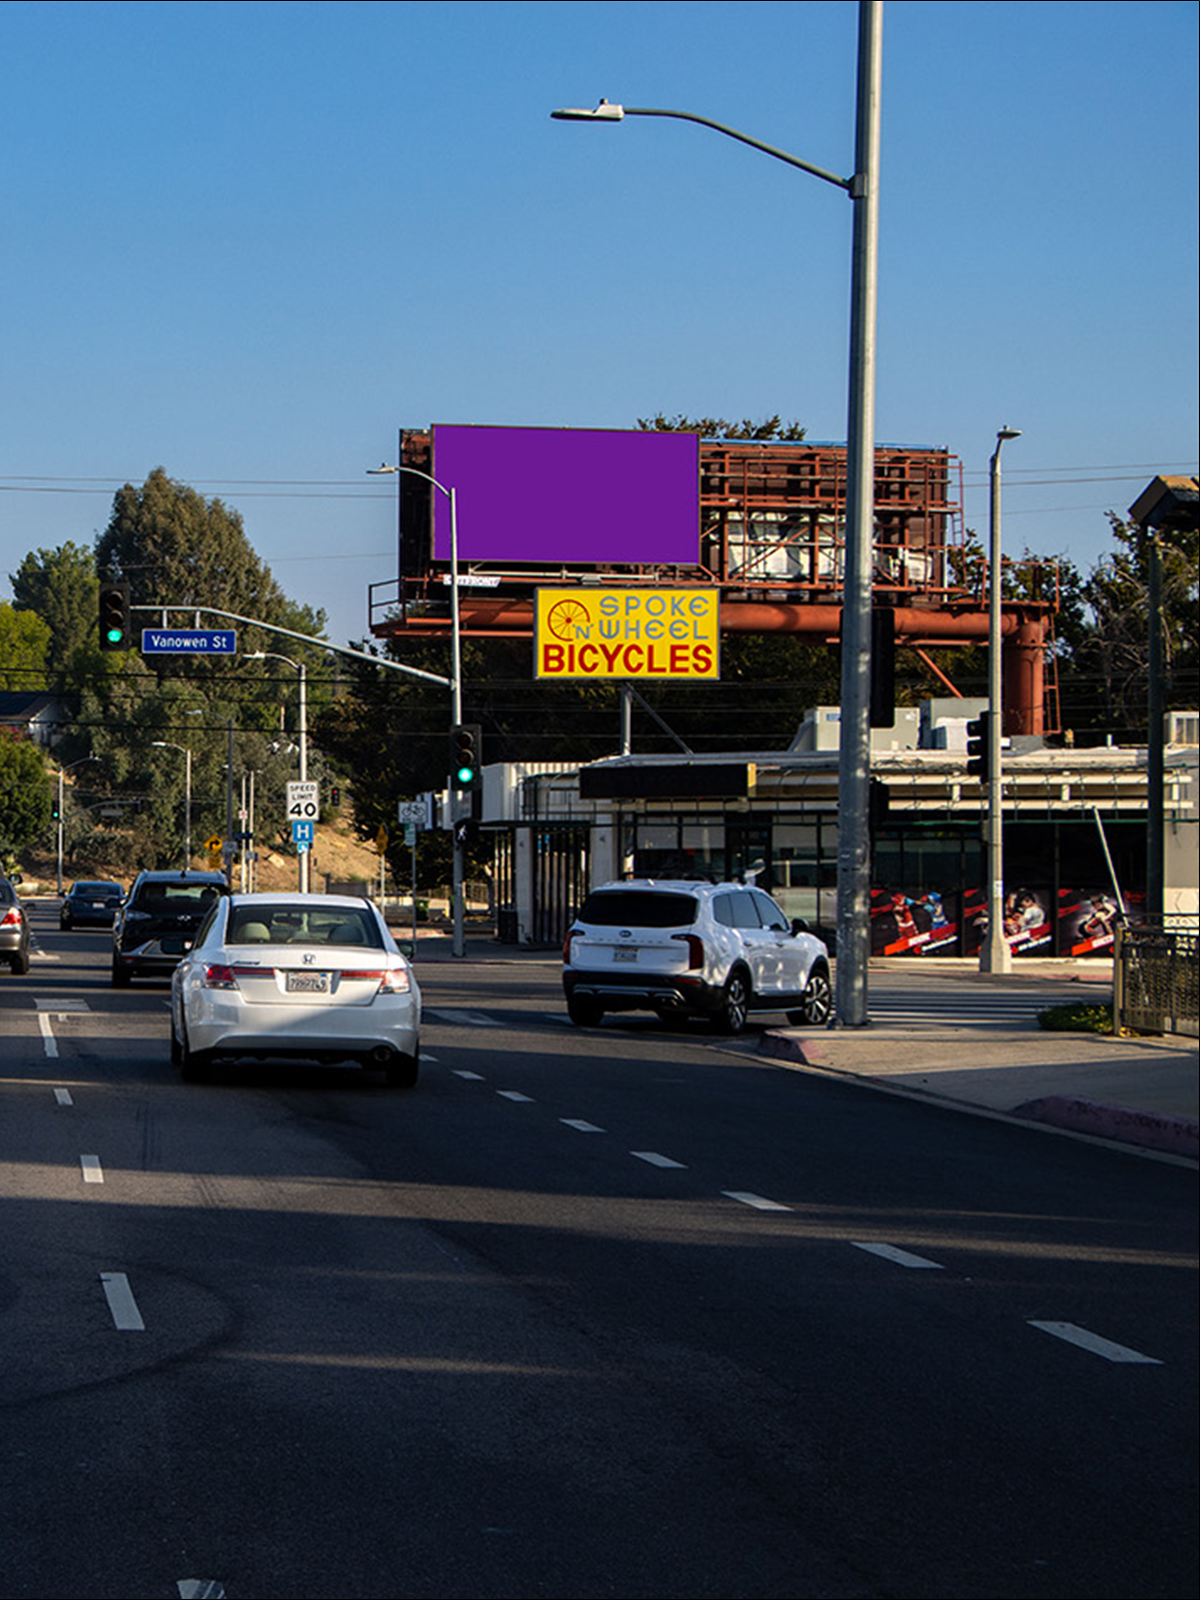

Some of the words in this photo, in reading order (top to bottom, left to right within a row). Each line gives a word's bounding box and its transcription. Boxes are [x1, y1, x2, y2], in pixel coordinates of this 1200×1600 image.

[599, 596, 709, 616] SPOKE
[599, 620, 709, 640] WHEEL
[151, 635, 207, 648] Vanowen
[212, 635, 227, 649] St
[543, 644, 712, 673] BICYCLES
[290, 784, 316, 792] SPEED
[290, 802, 316, 817] 40
[297, 824, 309, 839] H
